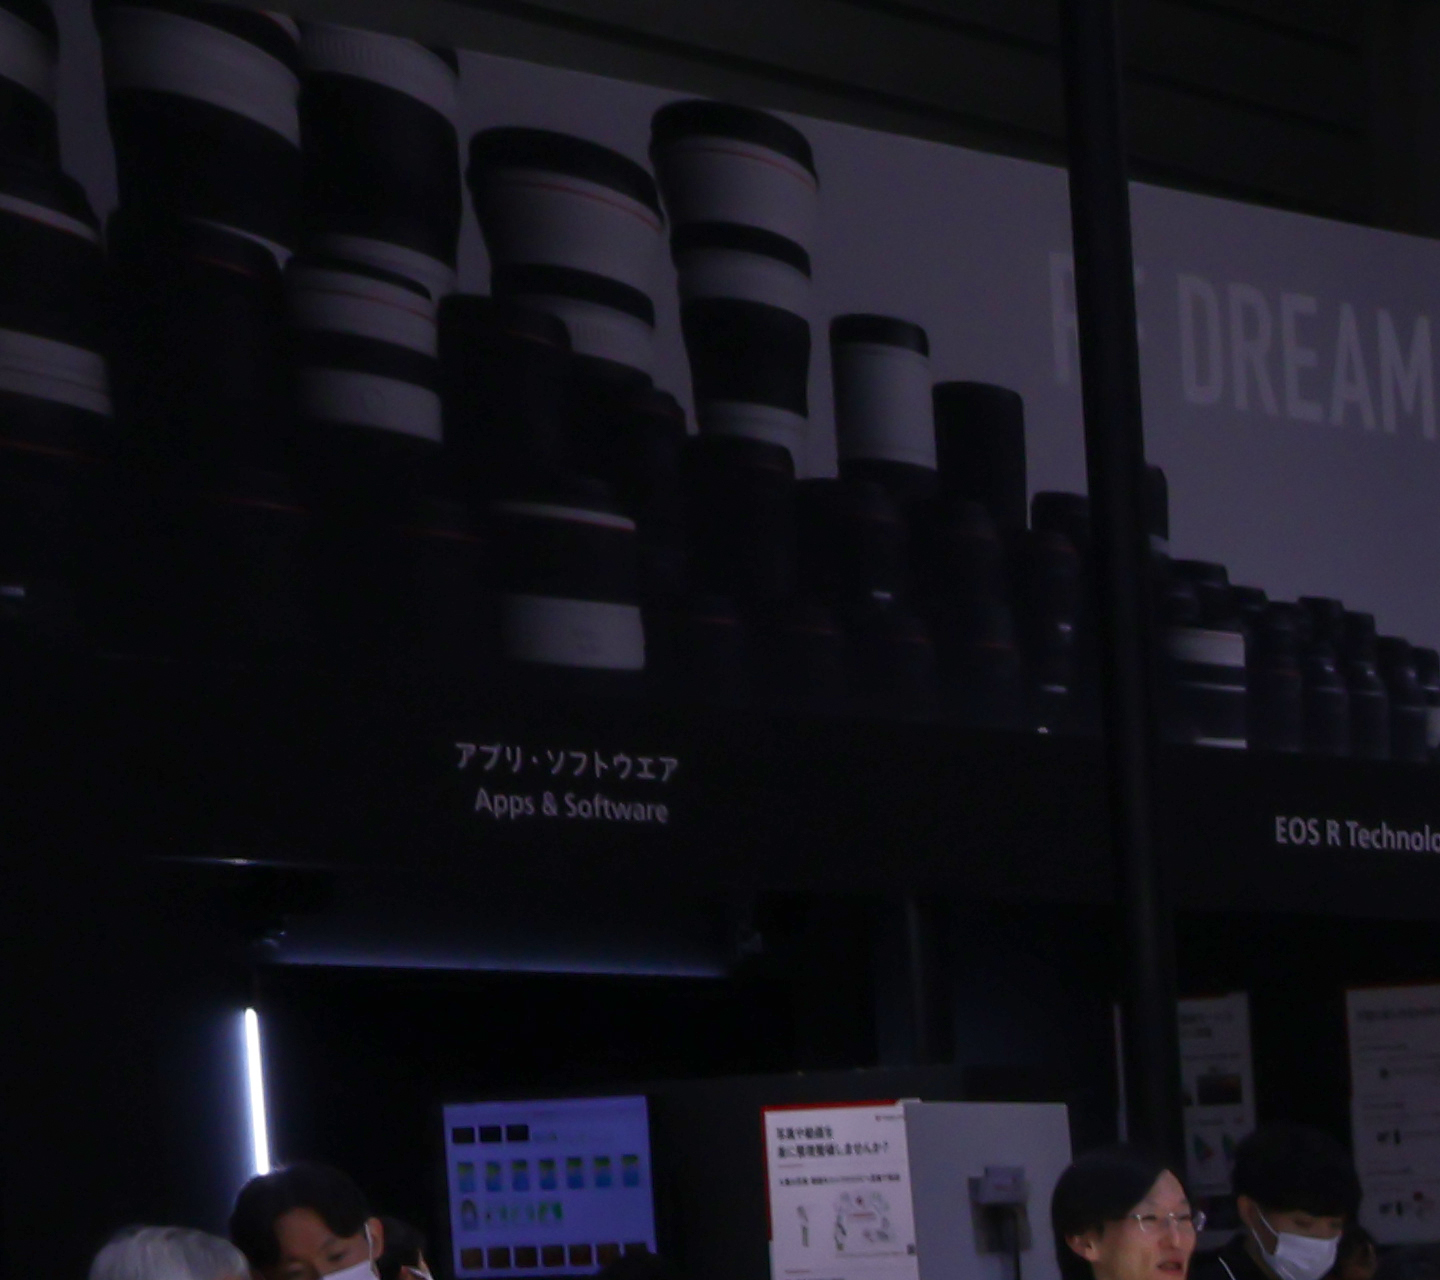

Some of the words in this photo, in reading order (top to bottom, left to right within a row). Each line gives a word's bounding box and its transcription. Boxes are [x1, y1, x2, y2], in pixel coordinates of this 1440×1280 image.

[1177, 271, 1437, 440] DREAM
[475, 787, 535, 819] Apps
[542, 791, 559, 817] &
[565, 791, 671, 825] Software
[1275, 815, 1321, 846] EOS
[1326, 819, 1341, 846] R
